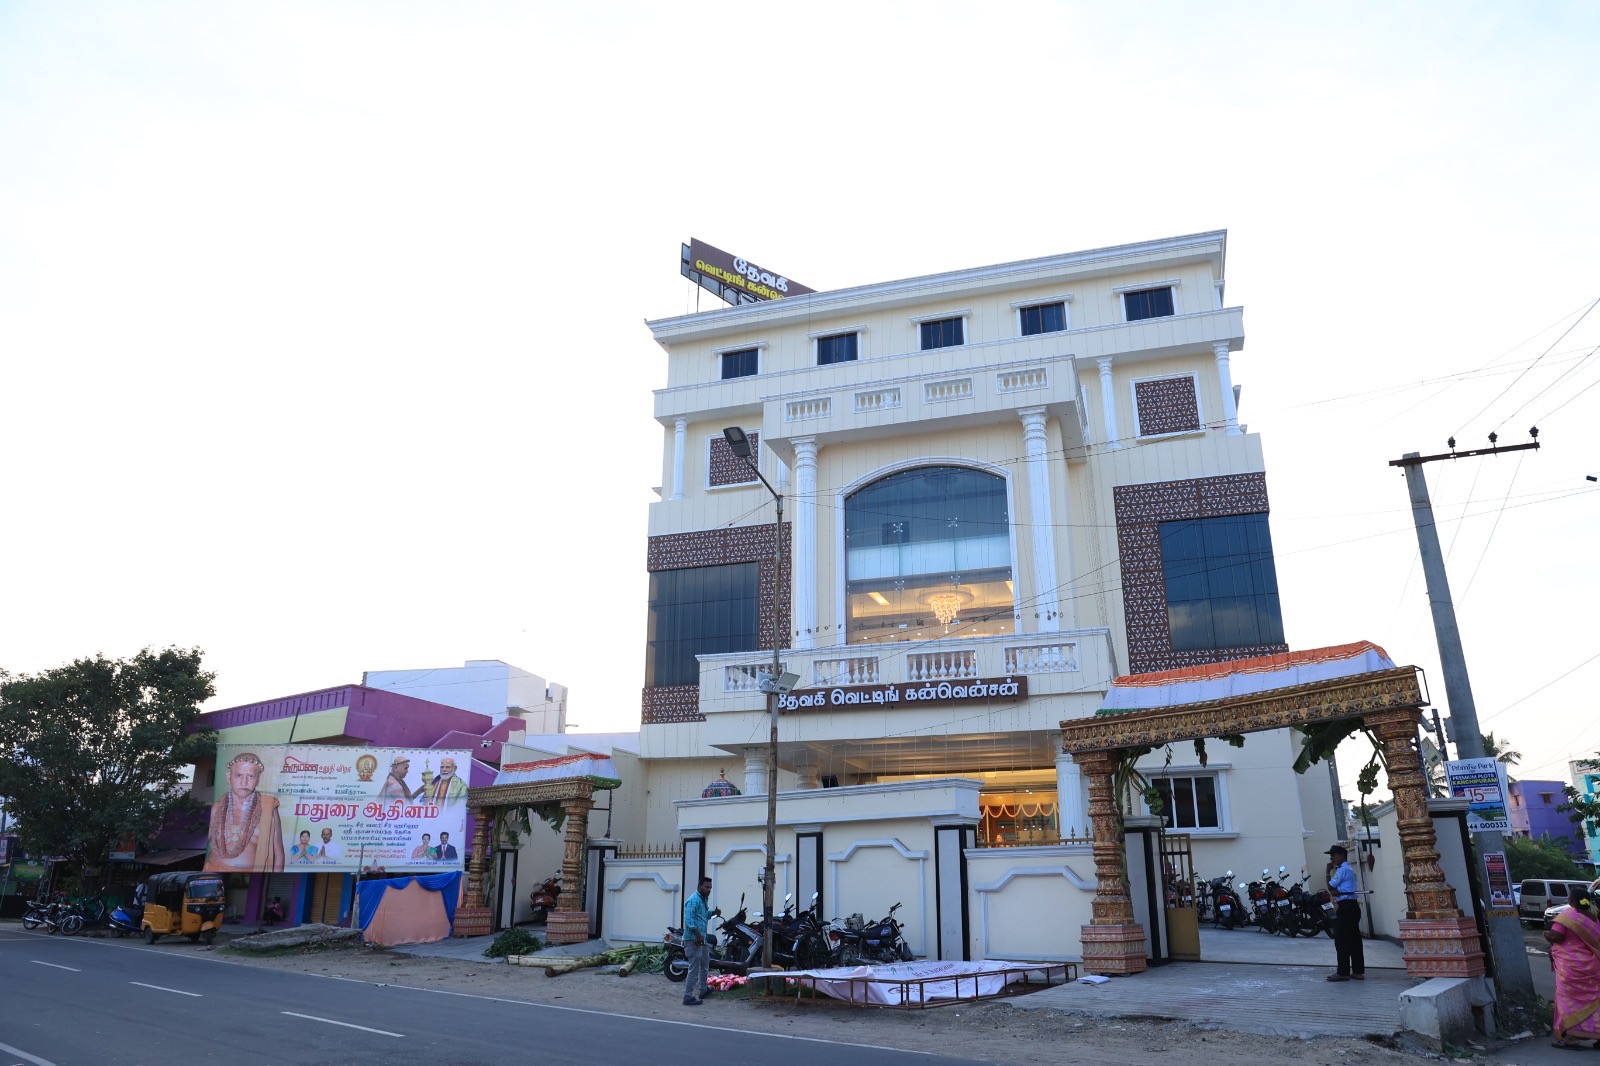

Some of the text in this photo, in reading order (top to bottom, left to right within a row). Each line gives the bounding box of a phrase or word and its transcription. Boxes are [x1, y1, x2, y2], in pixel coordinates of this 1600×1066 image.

[695, 259, 745, 287] வெட்டிங்
[830, 685, 900, 705] வெட்டிங்
[905, 678, 1019, 701] கன்வென்சன்
[1467, 788, 1485, 802] 15
[294, 802, 360, 822] மதுரை
[1480, 821, 1508, 829] 000333
